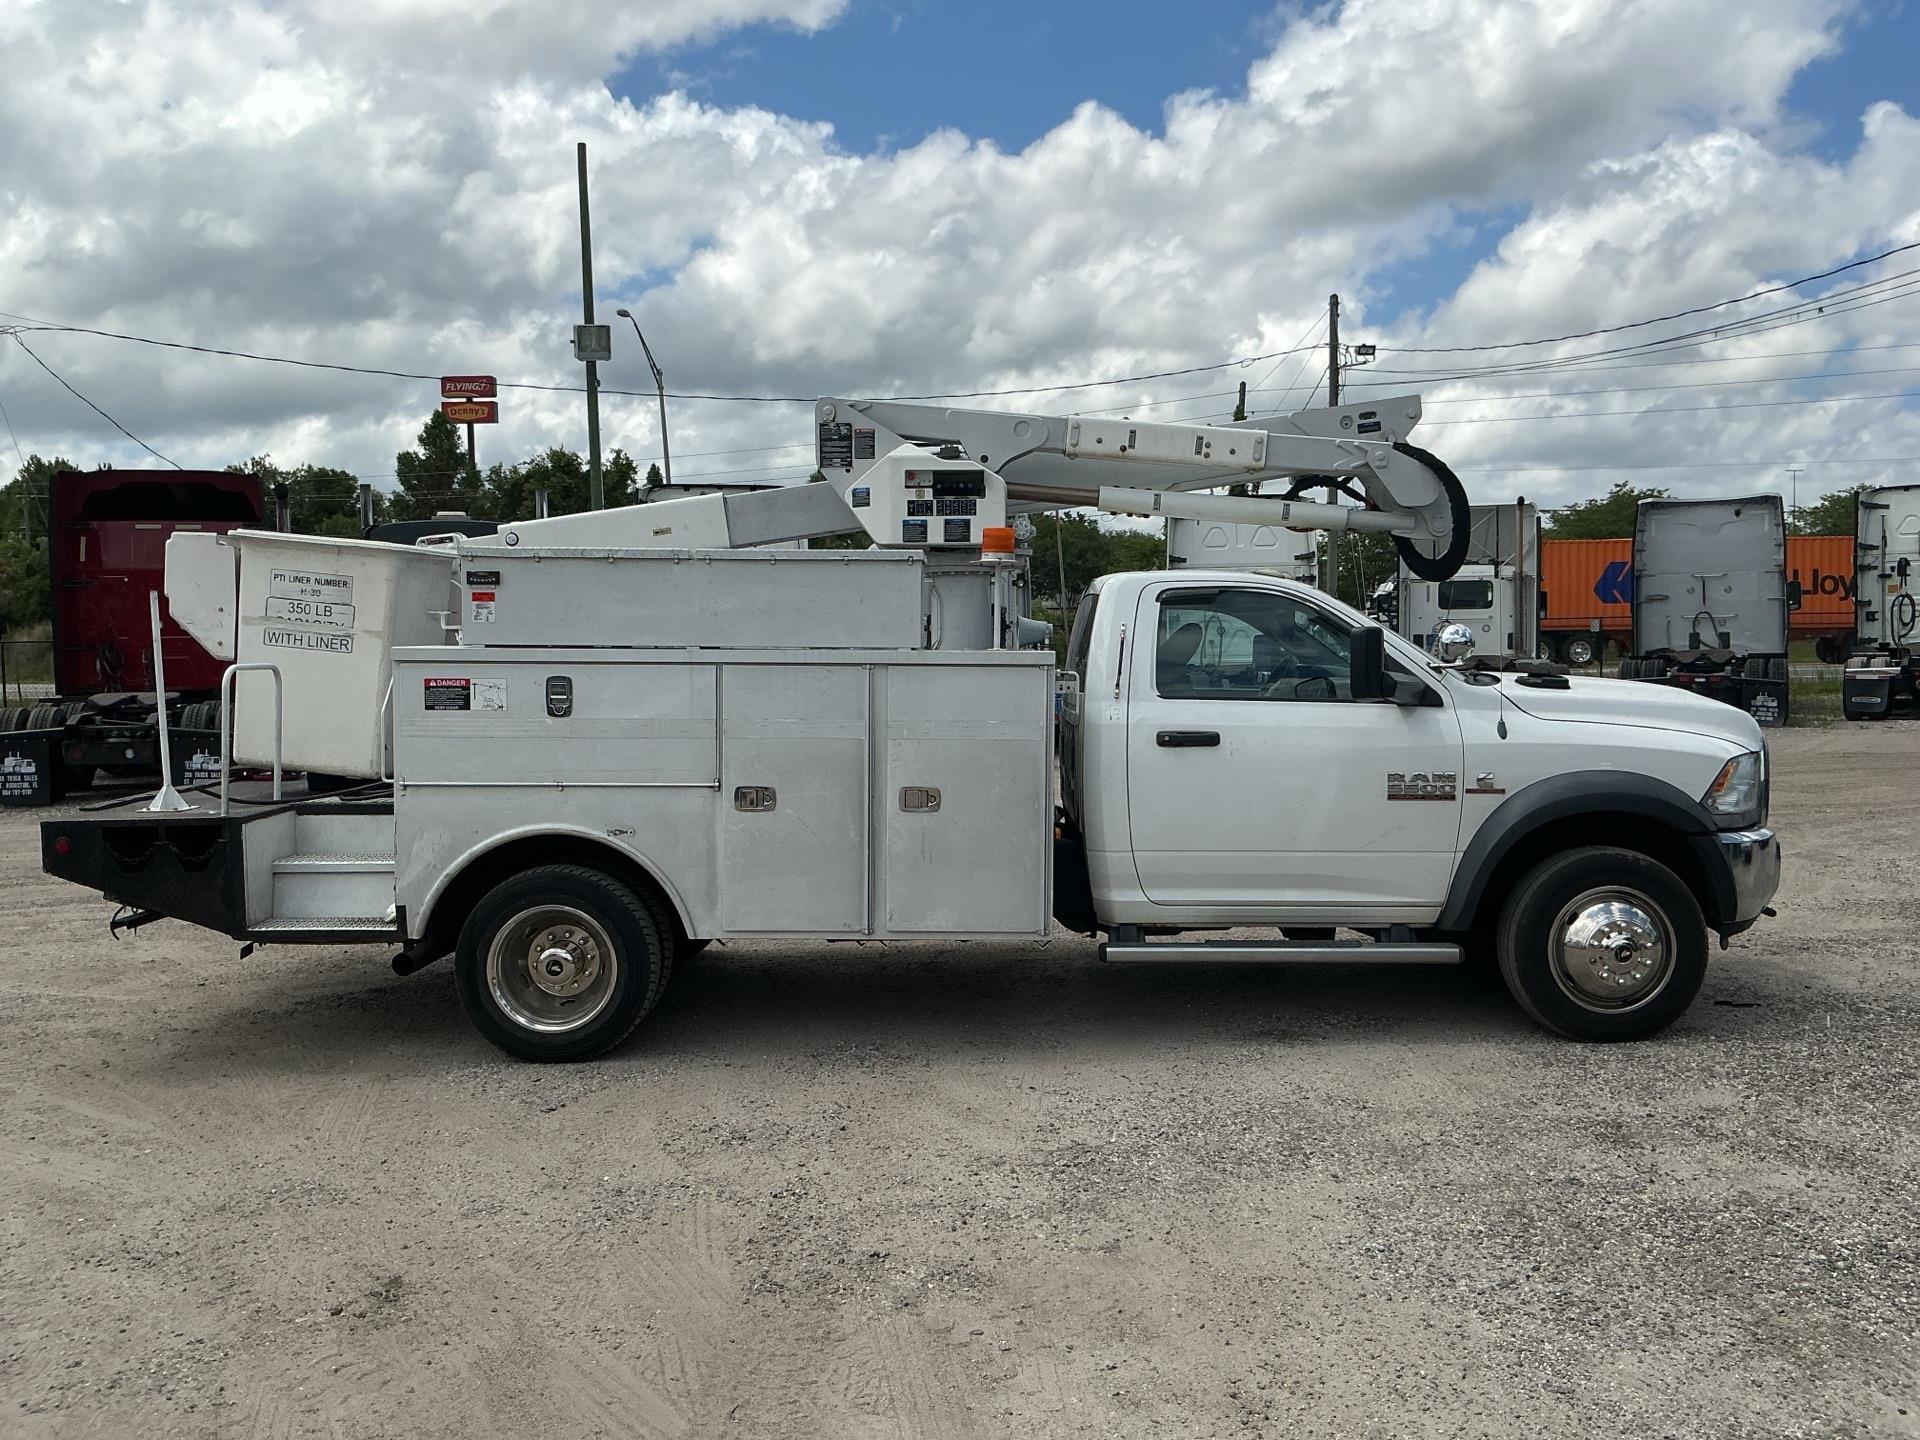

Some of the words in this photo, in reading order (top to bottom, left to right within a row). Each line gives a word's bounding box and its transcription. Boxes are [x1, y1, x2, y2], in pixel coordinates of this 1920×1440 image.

[446, 382, 480, 391] FLYING
[450, 408, 486, 416] Denny's
[273, 574, 286, 582] PTI
[288, 575, 311, 584] LINER
[287, 602, 311, 615] 350
[315, 604, 333, 617] LB
[267, 631, 303, 646] WITH
[307, 635, 350, 651] LINER
[1387, 772, 1456, 783] RAM
